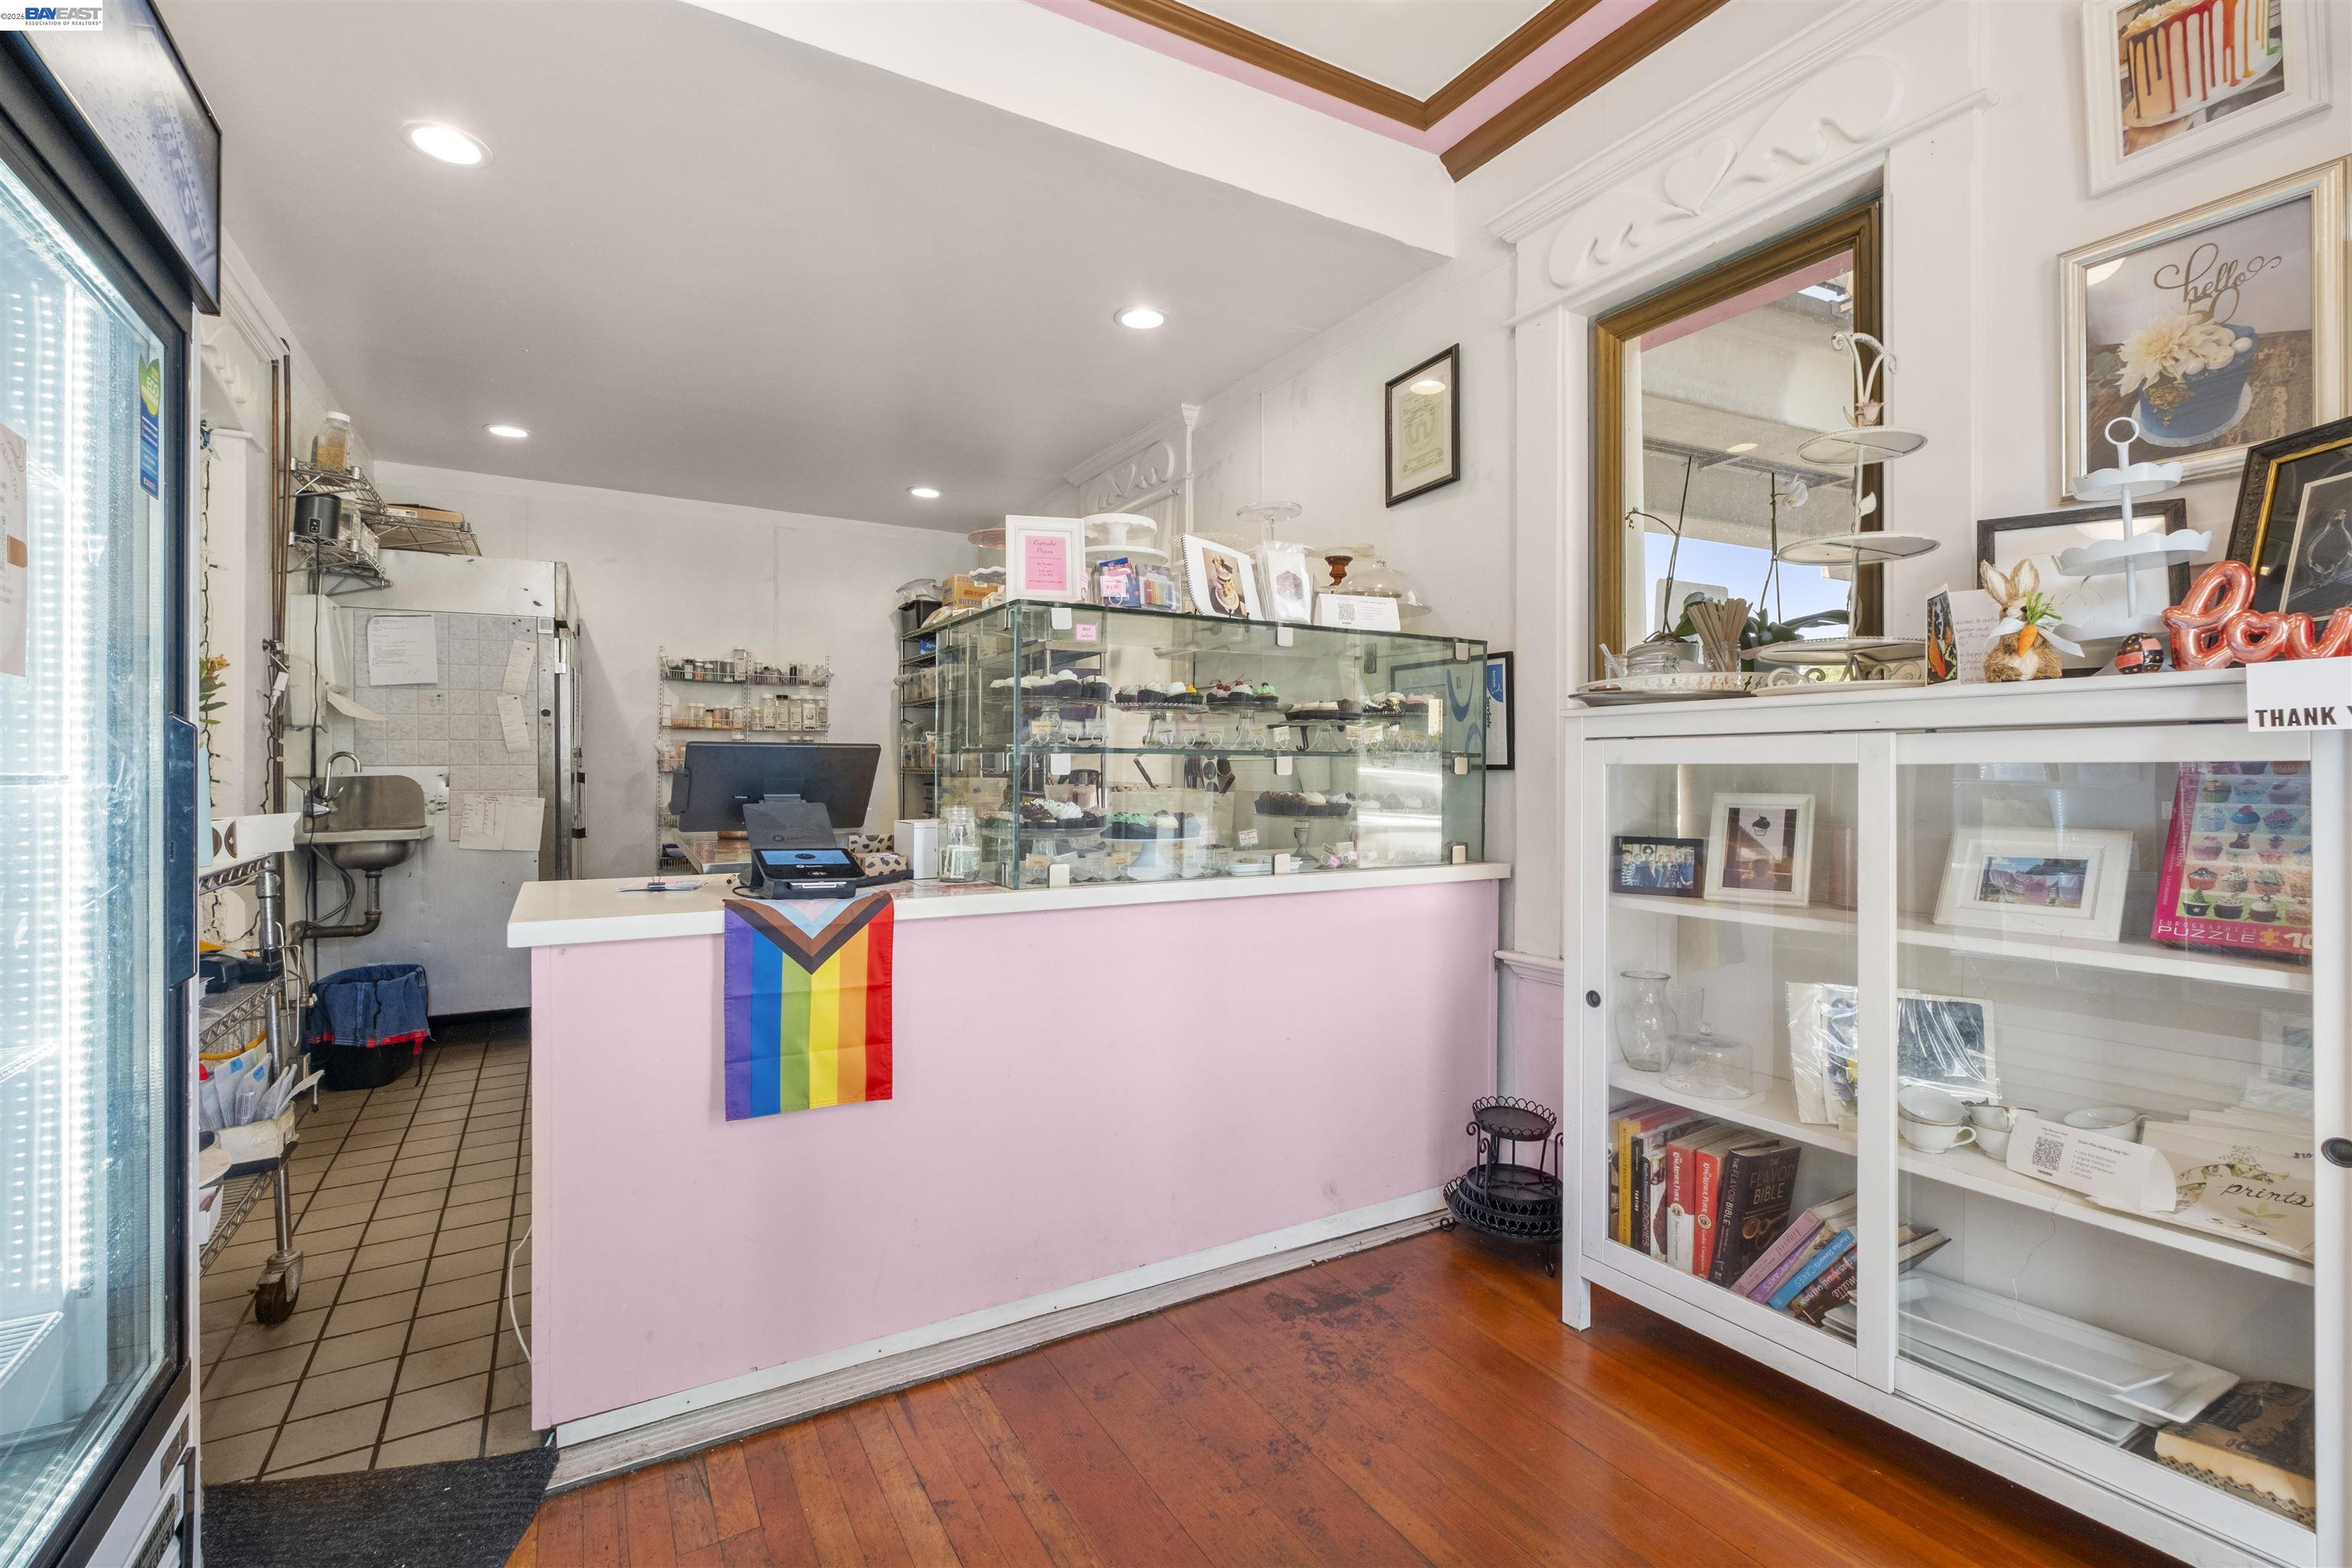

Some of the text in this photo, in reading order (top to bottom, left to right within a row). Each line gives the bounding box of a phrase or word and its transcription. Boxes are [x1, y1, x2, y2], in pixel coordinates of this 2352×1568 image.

[2153, 243, 2282, 303] hello
[2255, 707, 2337, 727] THANK
[2158, 926, 2255, 943] PUZZLE
[2159, 920, 2257, 935] EUROGRAPHICS
[1727, 1168, 1739, 1201] FLAVOR
[1749, 1165, 1795, 1188] FLAVOR
[1753, 1182, 1785, 1205] BIBLE
[2220, 1183, 2314, 1207] prints
[1723, 1200, 1733, 1225] BIBLE
[1642, 1202, 1650, 1247] COOKIES
